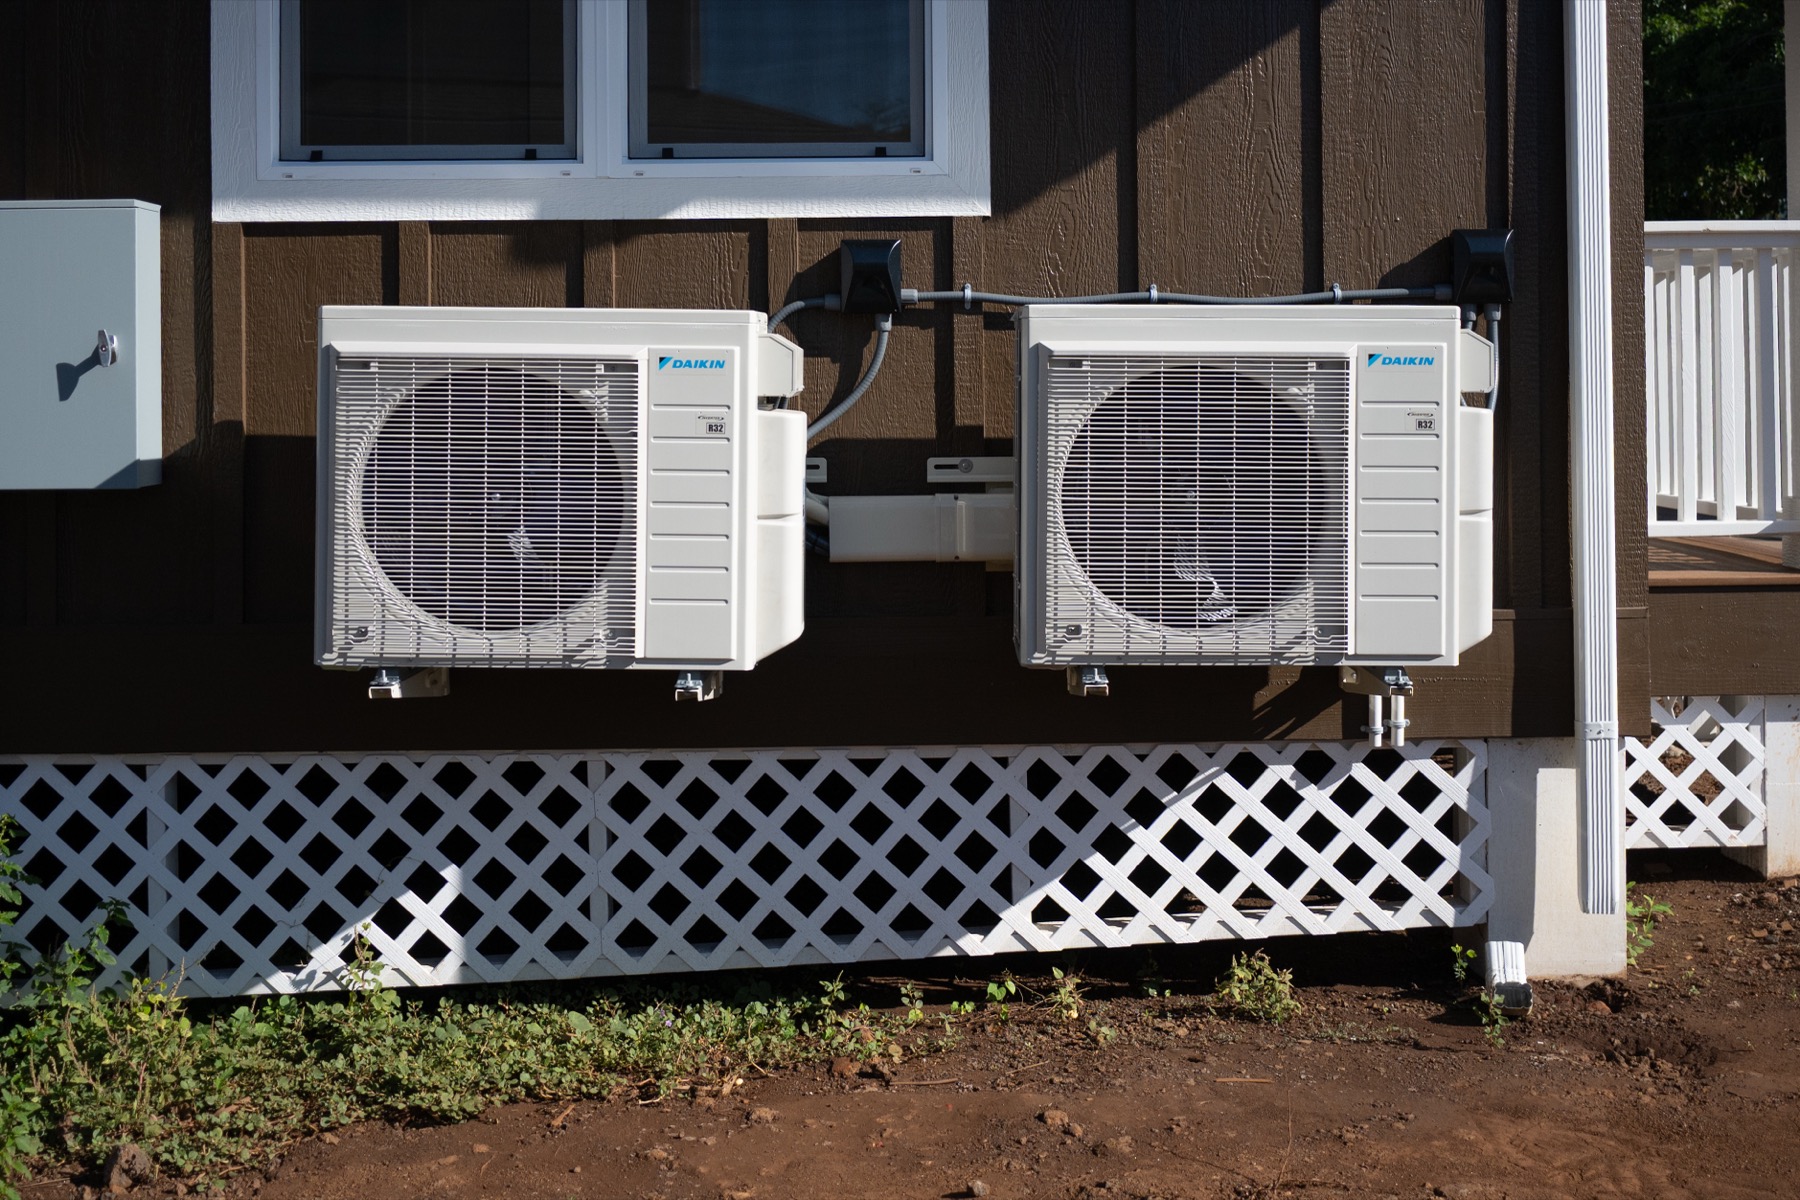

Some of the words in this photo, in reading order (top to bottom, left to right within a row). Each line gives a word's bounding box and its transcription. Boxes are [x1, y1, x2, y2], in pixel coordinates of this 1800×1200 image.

[672, 359, 725, 369] DAIKIN
[1381, 357, 1435, 366] DAIKIN
[708, 424, 724, 433] R32
[1417, 420, 1433, 429] R32
